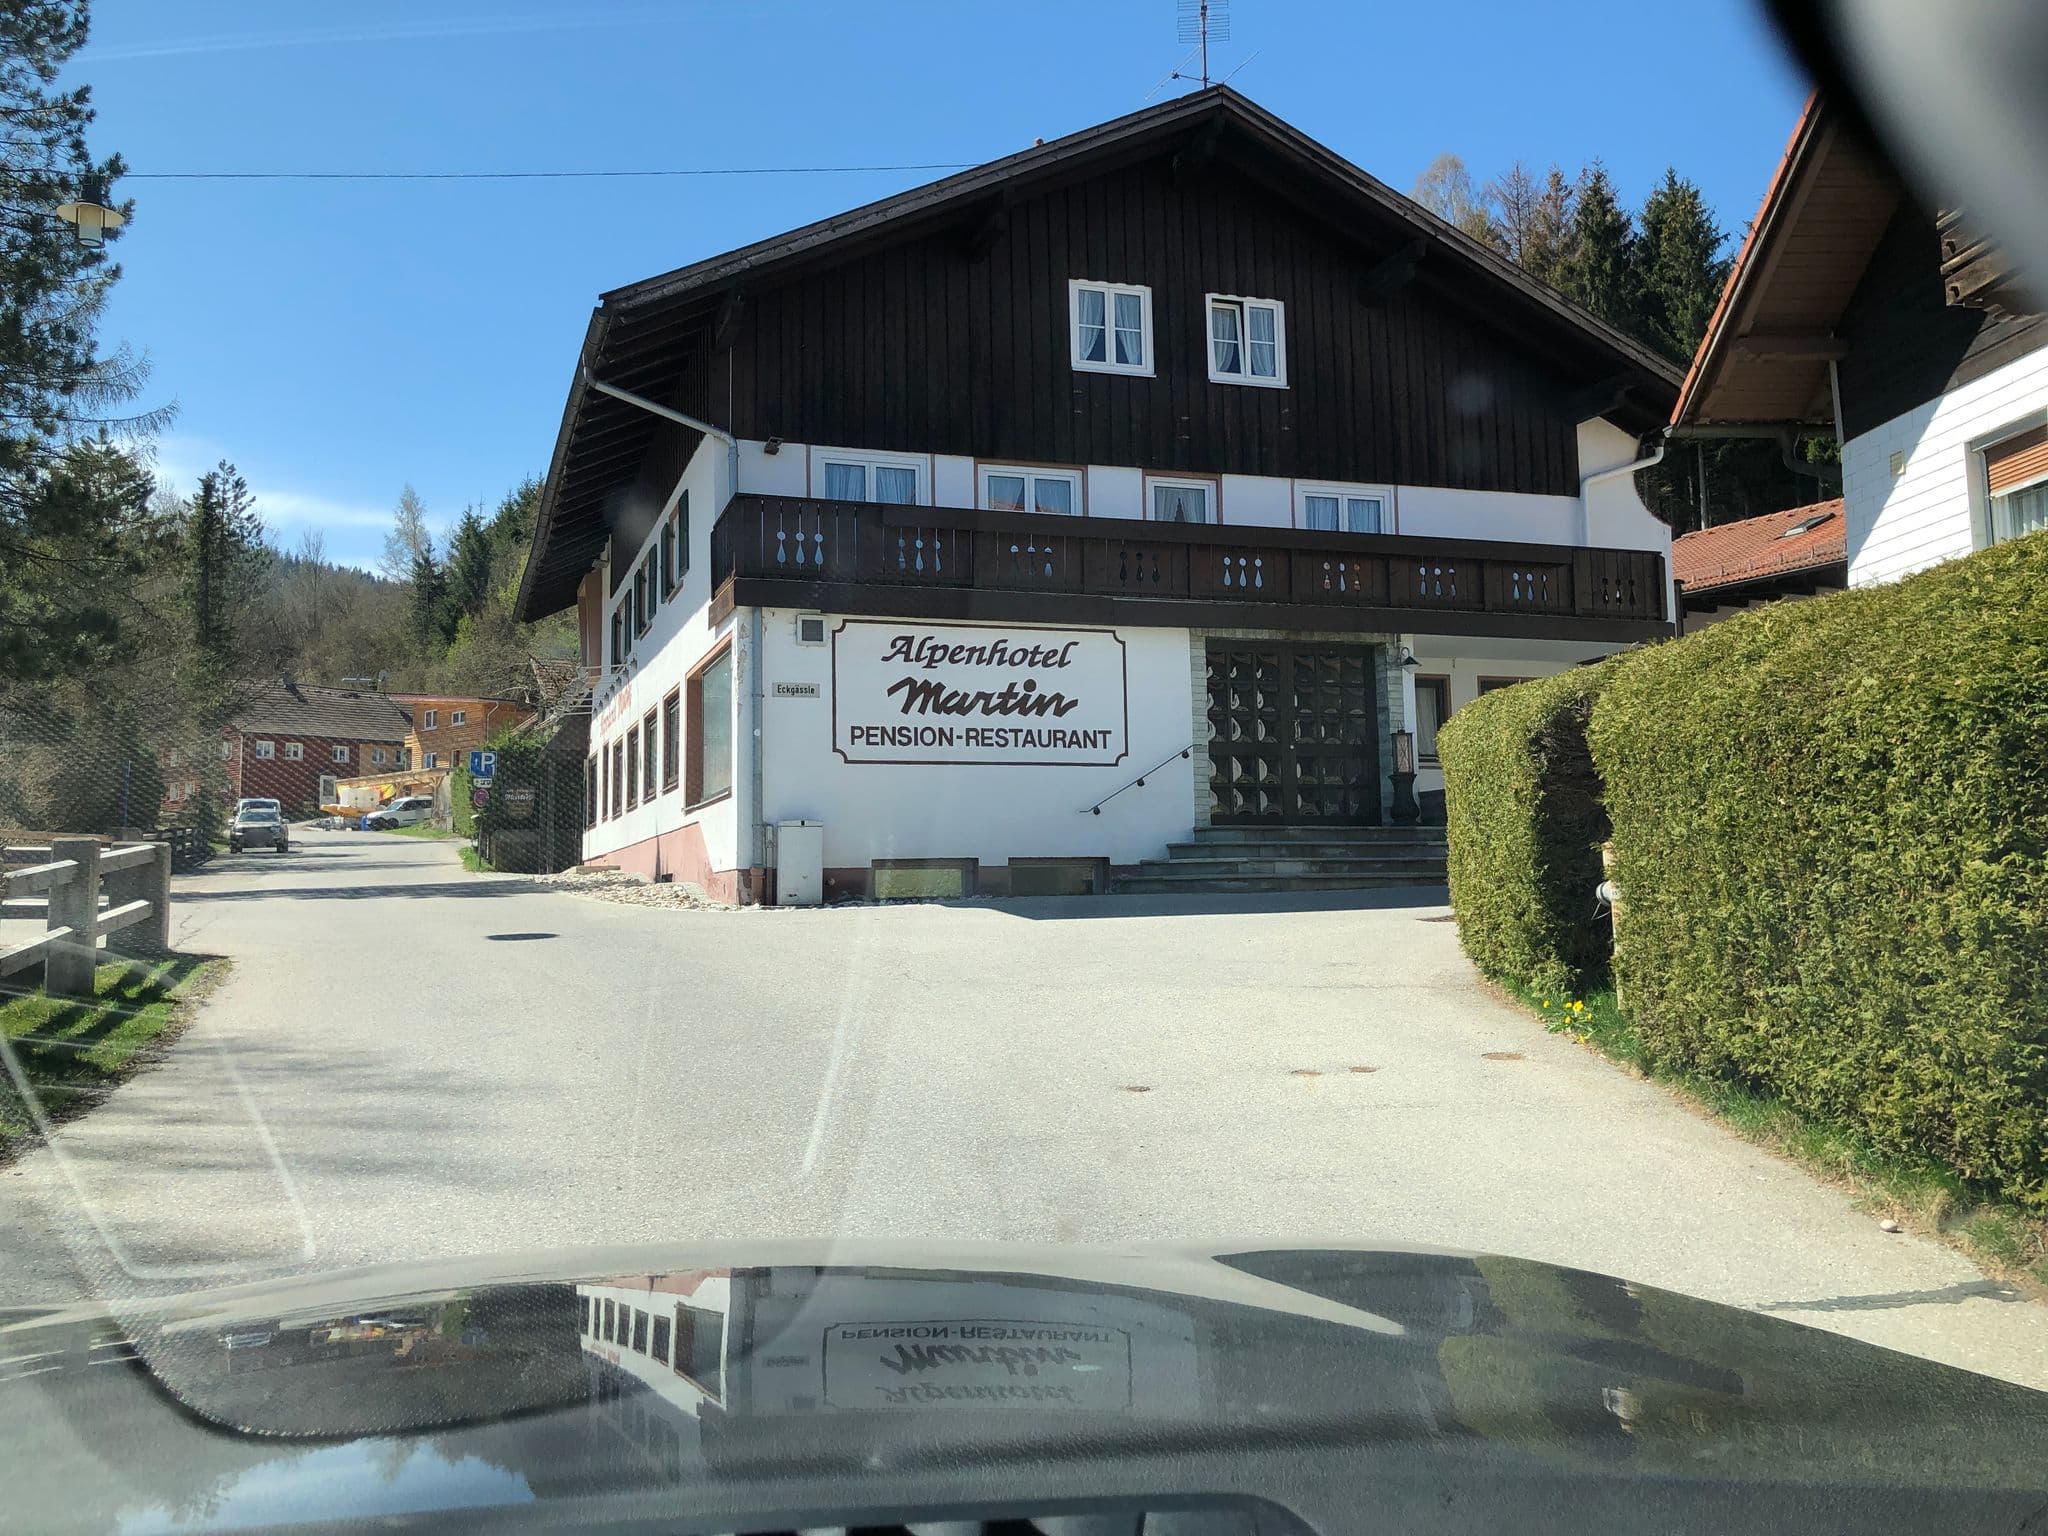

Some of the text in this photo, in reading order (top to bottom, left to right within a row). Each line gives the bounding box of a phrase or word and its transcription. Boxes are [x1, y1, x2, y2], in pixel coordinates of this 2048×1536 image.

[881, 635, 1079, 669] Alpenhotel
[776, 684, 816, 696] Eckgässle
[887, 676, 1079, 717] Martin
[850, 725, 1112, 749] PENSION-RESTAURANT
[481, 752, 495, 772] P
